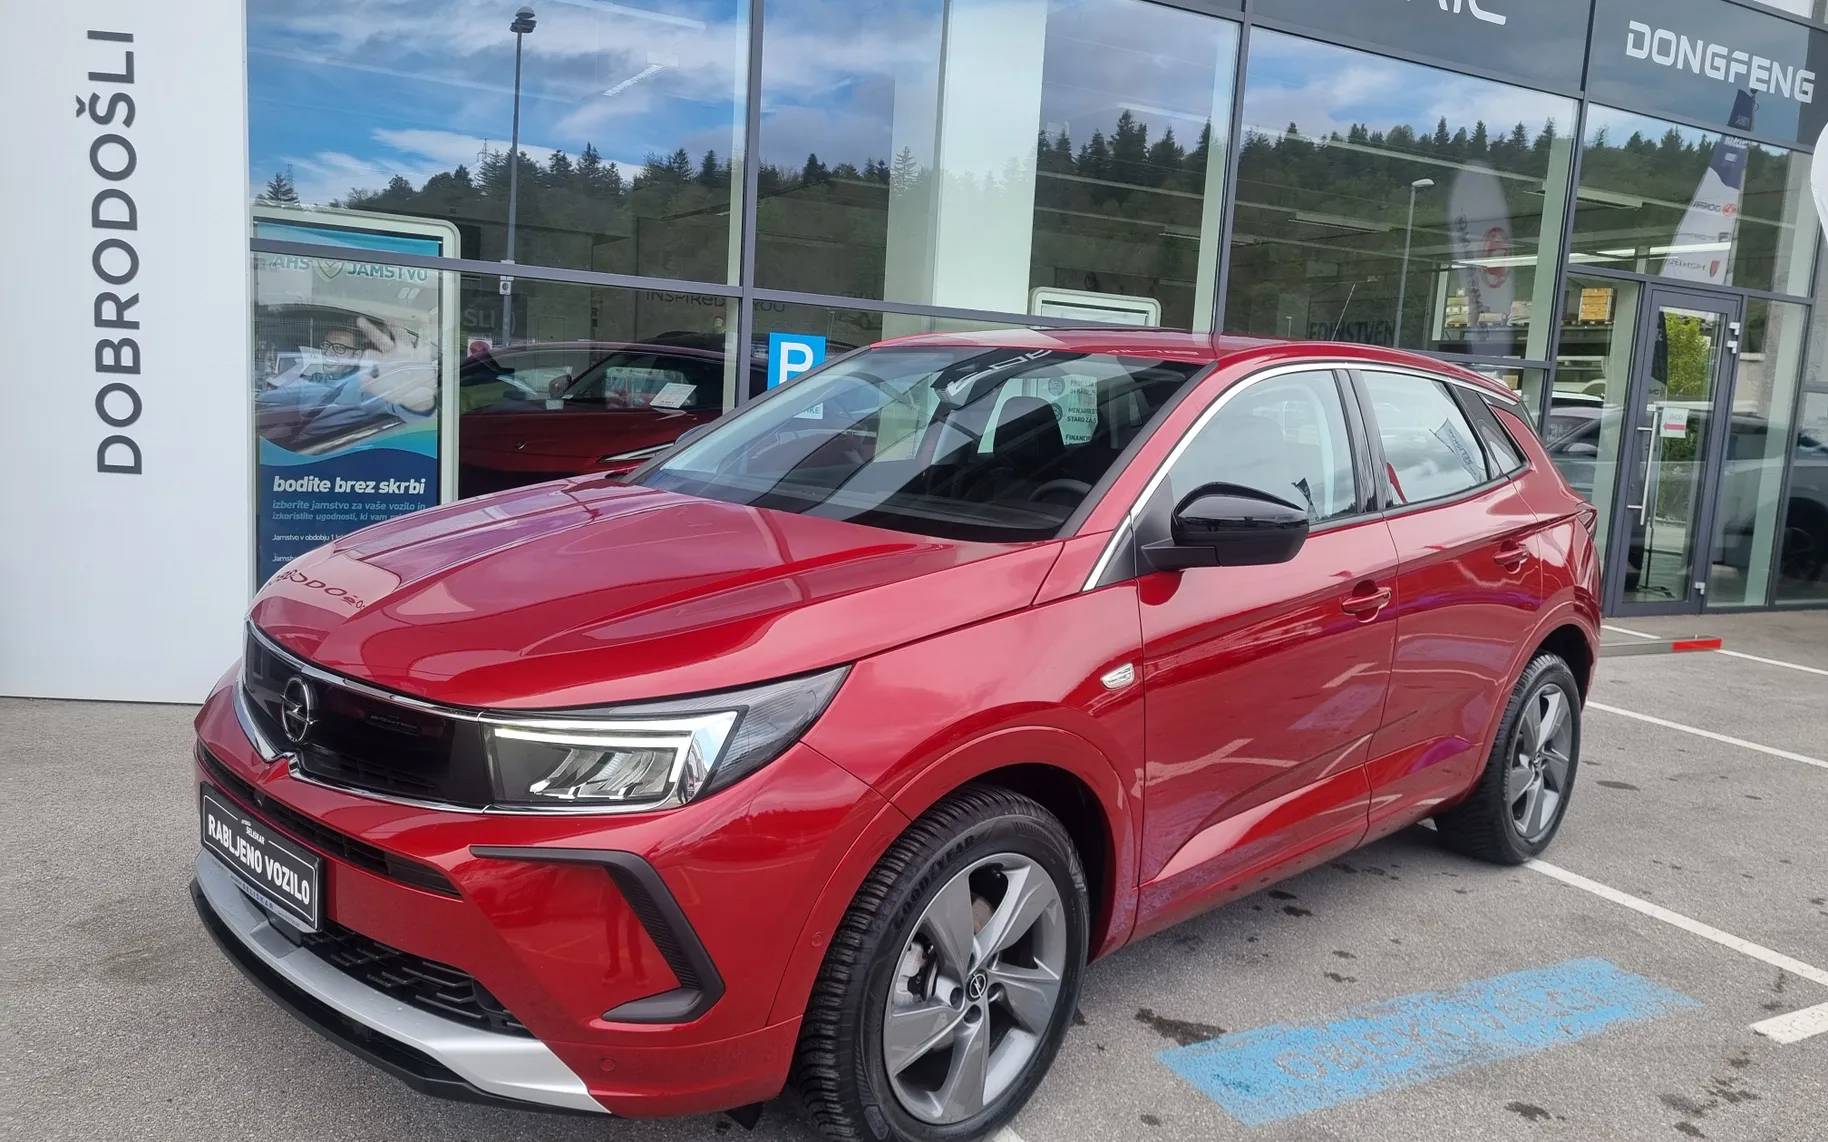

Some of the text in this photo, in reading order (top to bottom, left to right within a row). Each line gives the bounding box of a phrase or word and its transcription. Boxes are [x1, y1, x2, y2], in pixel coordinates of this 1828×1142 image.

[1626, 20, 1816, 104] DONGFENG
[76, 30, 142, 475] DOBRODOŠLI
[779, 341, 814, 384] P
[273, 475, 426, 495] bodite brez skrbi
[272, 500, 310, 509] izberite
[310, 500, 350, 510] jamstvo
[365, 501, 386, 511] vaše
[389, 502, 415, 511] vozilo
[272, 511, 314, 521] izkoristite
[305, 533, 330, 543] obdobju
[208, 814, 310, 905] RABLJENO VOZILO
